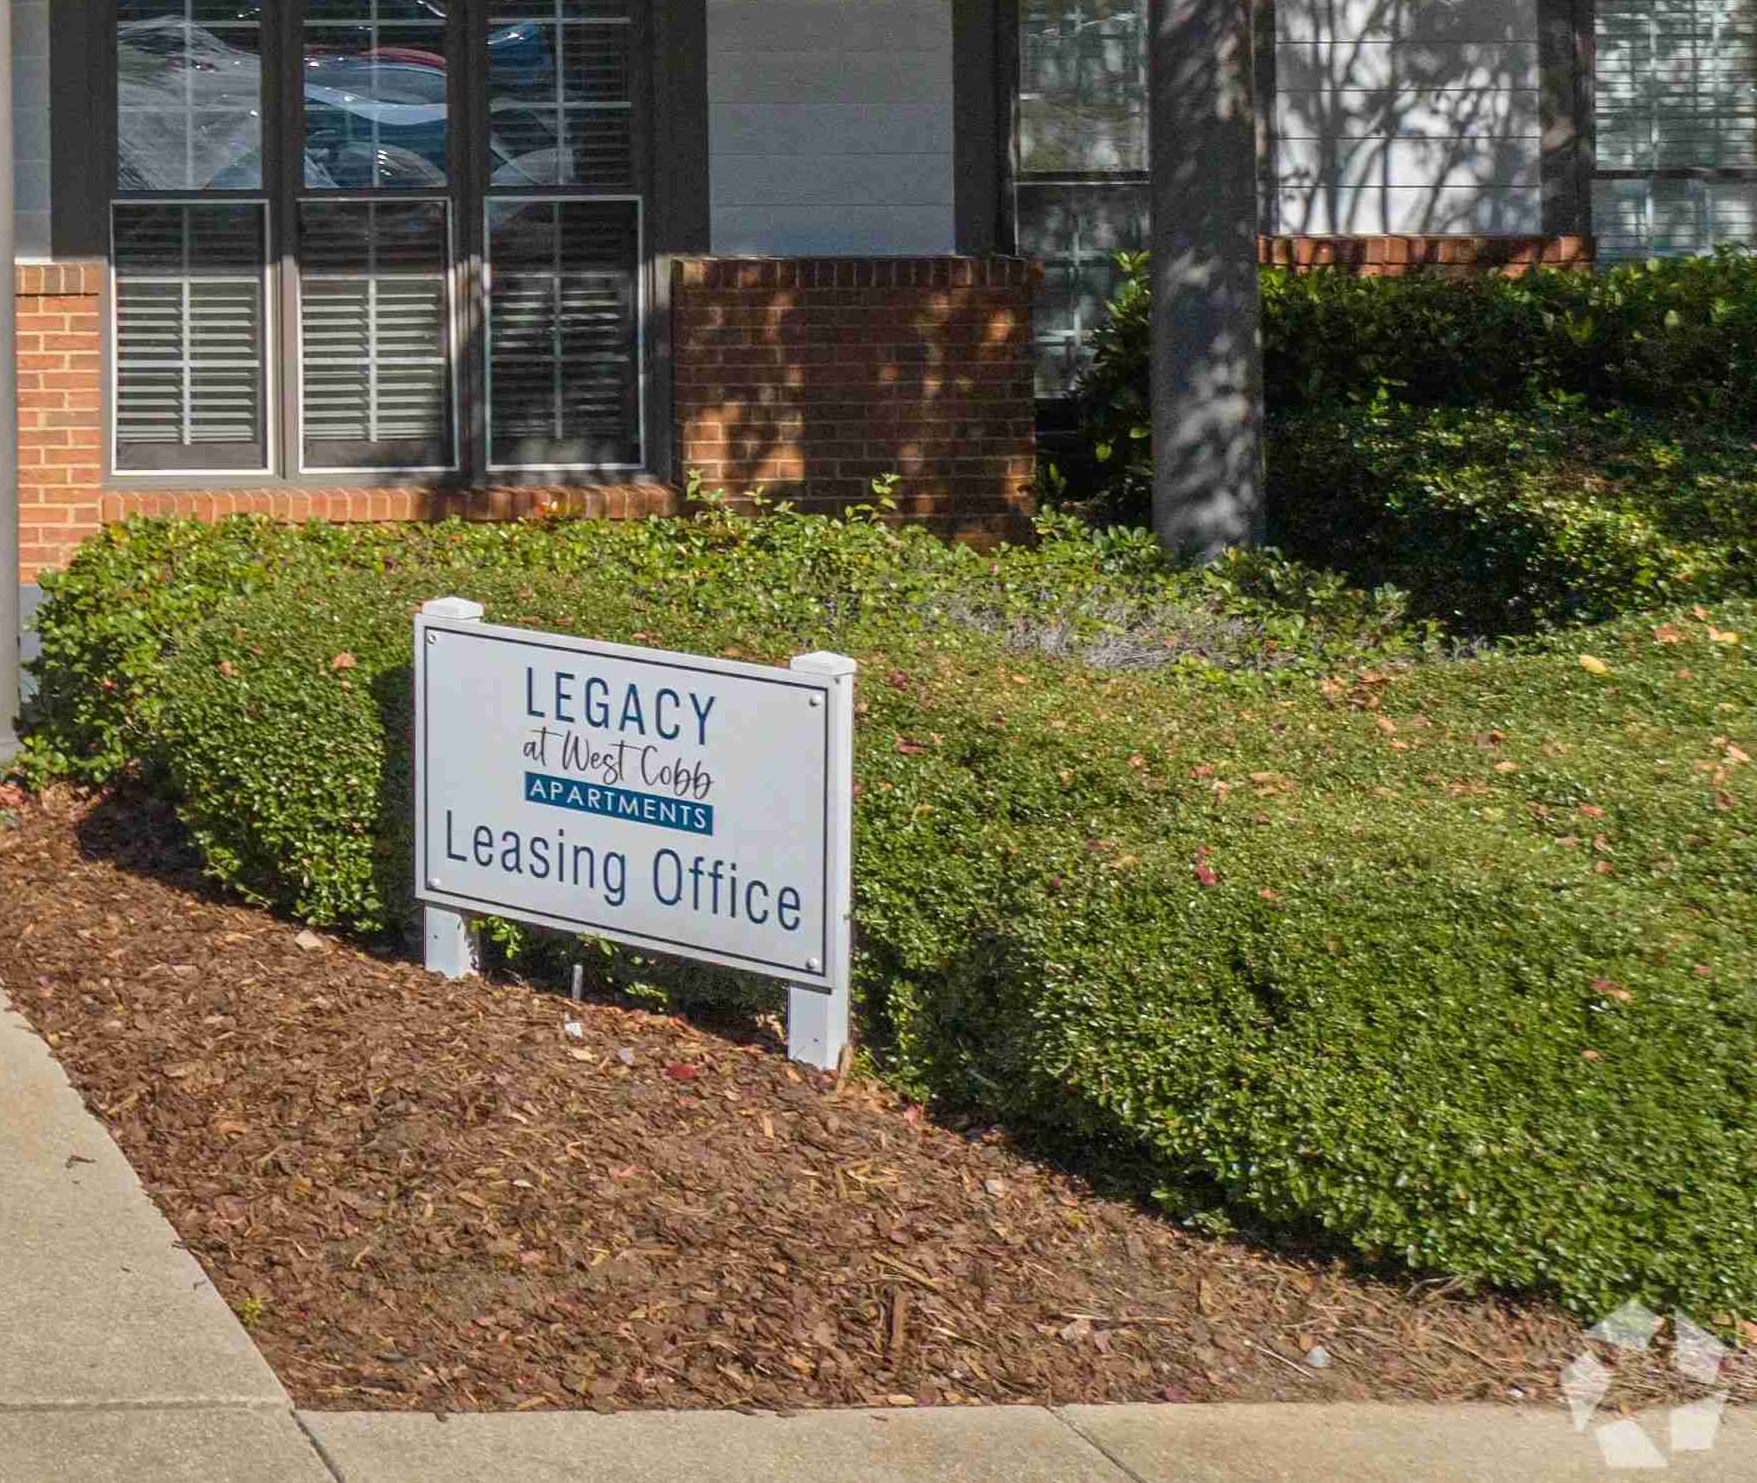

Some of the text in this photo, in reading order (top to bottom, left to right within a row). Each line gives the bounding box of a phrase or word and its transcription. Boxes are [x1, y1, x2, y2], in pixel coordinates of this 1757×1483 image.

[525, 667, 717, 745] LEGACY
[523, 726, 715, 799] at West Cobb
[529, 778, 707, 830] APARTMENTS
[446, 809, 800, 931] Leasing Office
